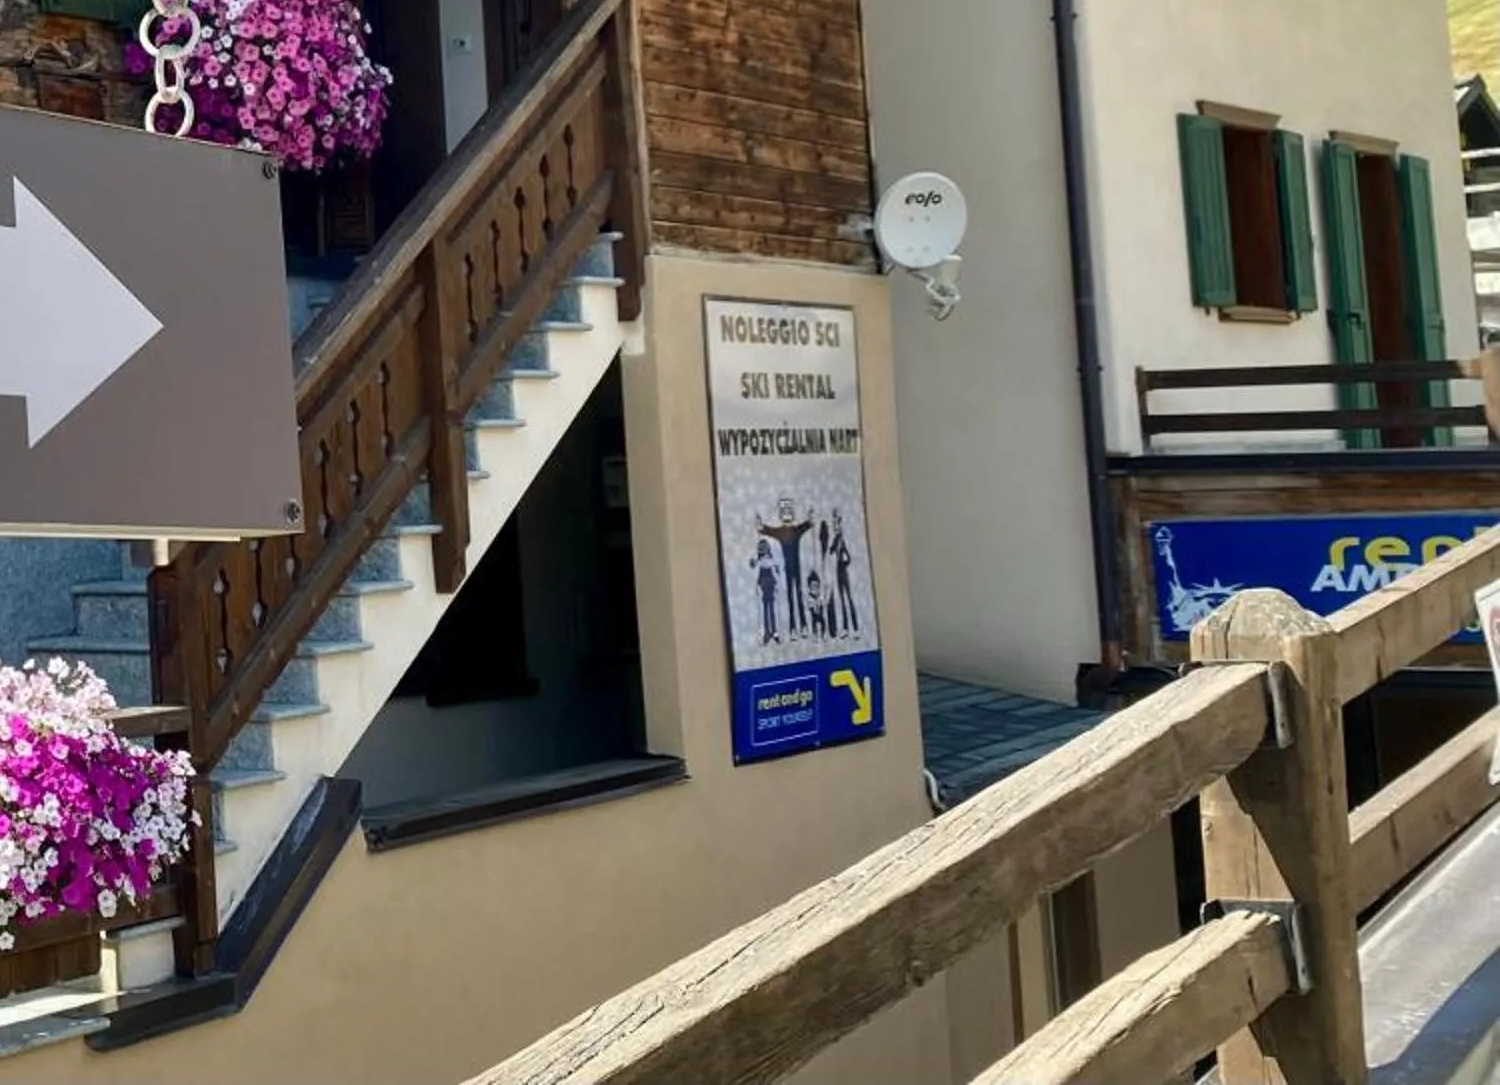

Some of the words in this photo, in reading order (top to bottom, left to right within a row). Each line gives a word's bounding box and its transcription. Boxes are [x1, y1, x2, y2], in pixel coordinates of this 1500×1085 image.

[720, 315, 810, 346] NOLEGGIO
[815, 320, 841, 347] SCI
[740, 371, 770, 400] SKI
[775, 372, 836, 400] RENTAL
[1329, 526, 1493, 572] ren
